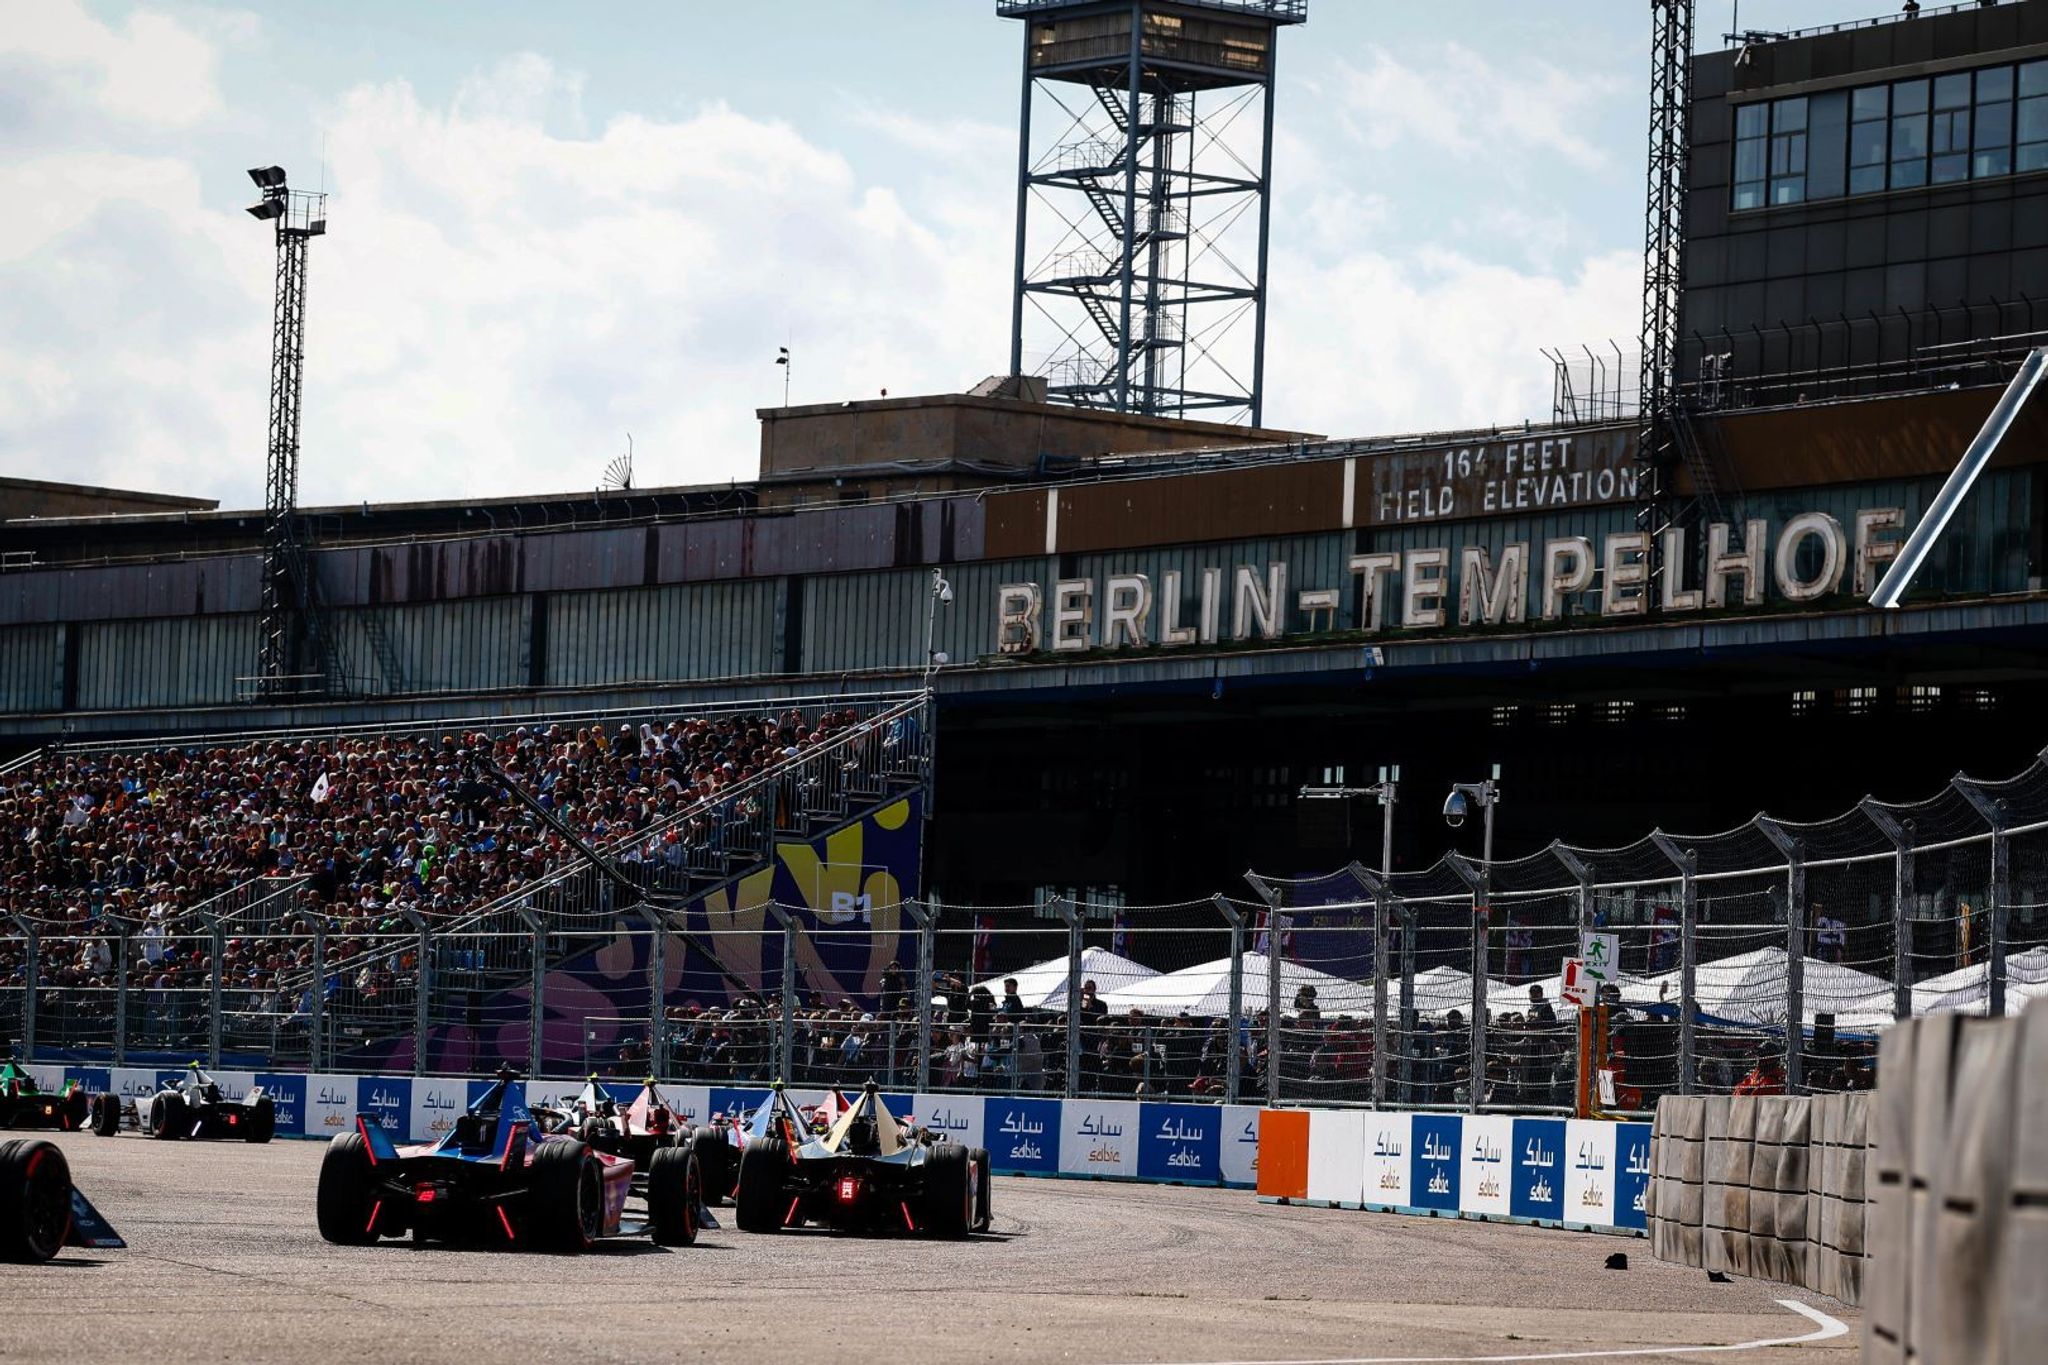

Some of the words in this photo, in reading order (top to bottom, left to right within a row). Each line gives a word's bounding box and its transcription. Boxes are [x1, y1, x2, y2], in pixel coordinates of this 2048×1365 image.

[1443, 447, 1488, 480] 164
[1505, 438, 1572, 474] FEET
[1380, 485, 1454, 521] FIELD
[1483, 466, 1637, 511] ELEVATION
[832, 891, 871, 922] B1
[324, 1109, 345, 1126] sabic
[379, 1111, 399, 1129] abic
[1010, 1138, 1042, 1160] sabic
[1088, 1142, 1121, 1163] sabic
[1167, 1145, 1201, 1167] sabic
[1428, 1167, 1450, 1194] sabic
[1478, 1170, 1500, 1197] sabic
[1529, 1174, 1552, 1203] sabic
[1582, 1178, 1603, 1207] sabic
